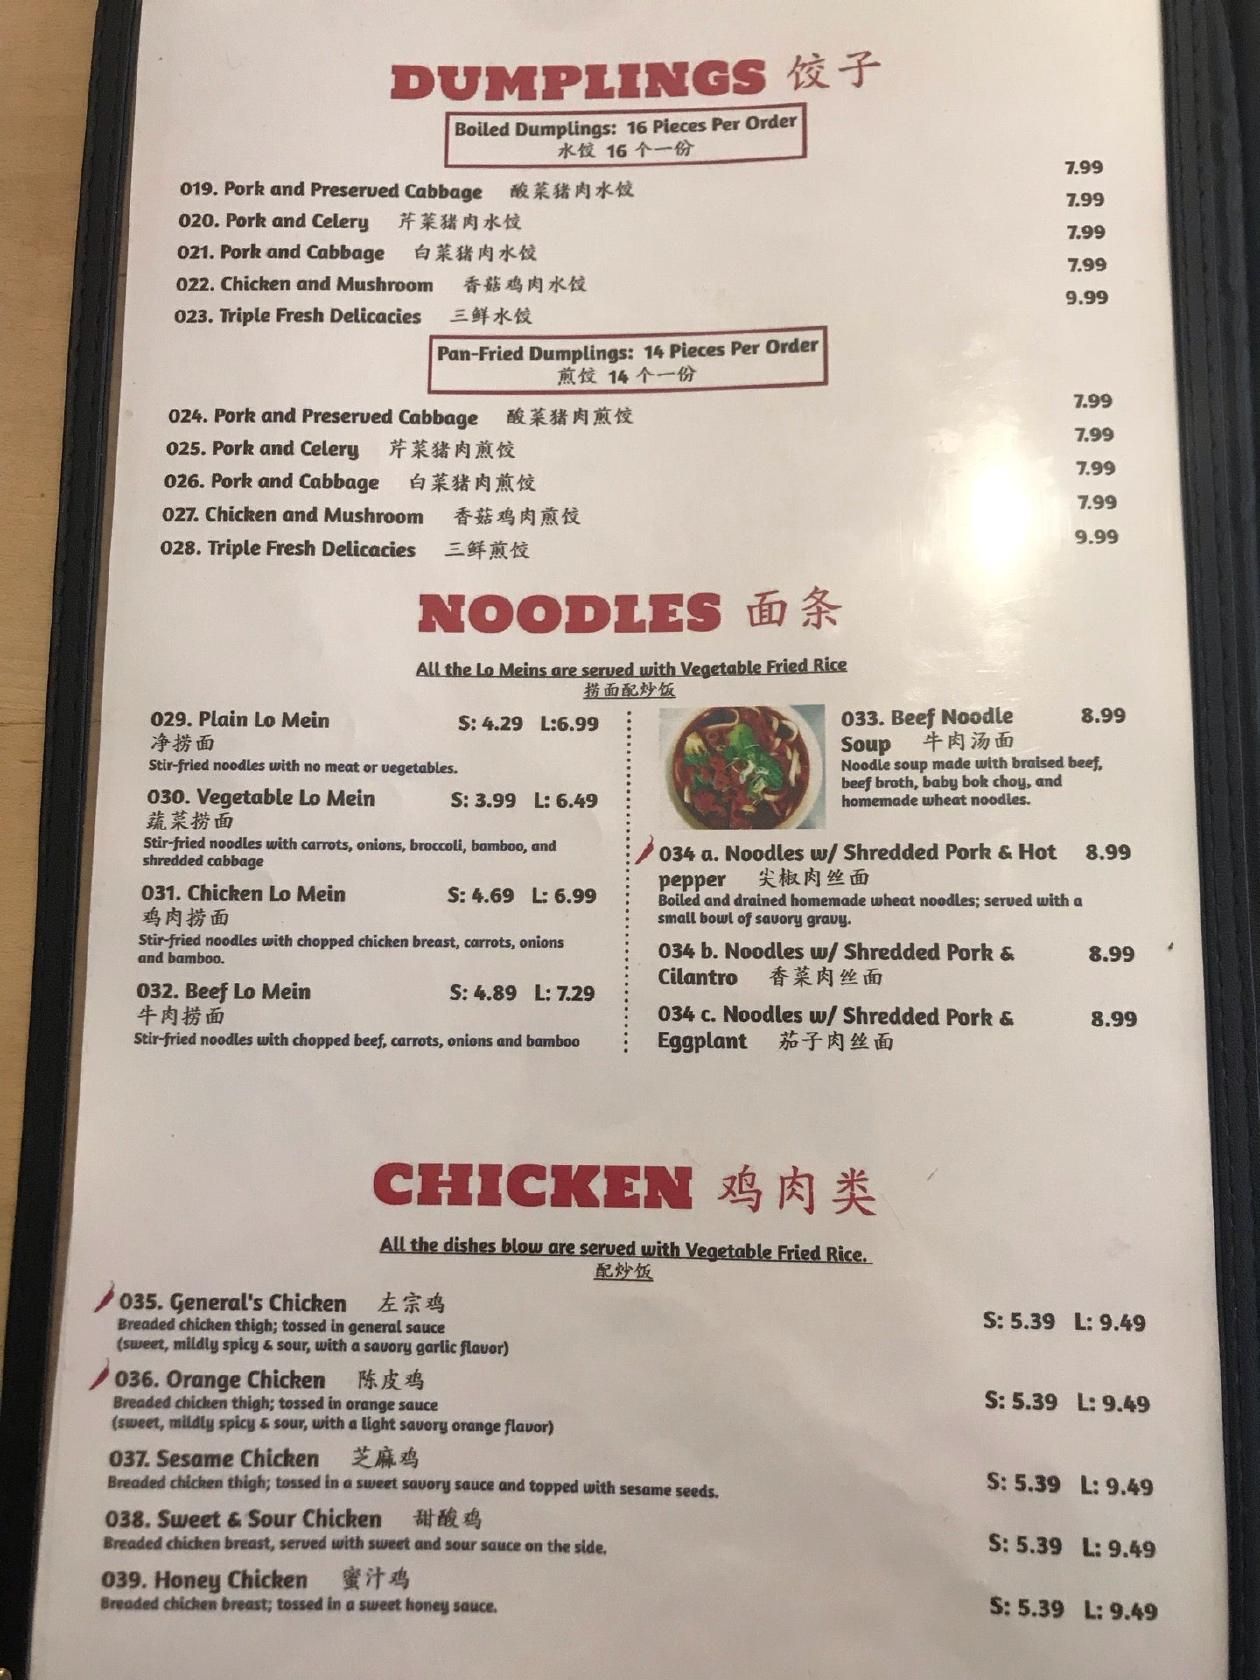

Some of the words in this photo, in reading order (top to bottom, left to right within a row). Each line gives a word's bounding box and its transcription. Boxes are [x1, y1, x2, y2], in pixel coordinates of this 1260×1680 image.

[391, 59, 766, 101] DUMPLINGS
[787, 50, 881, 90] 饺子
[455, 121, 510, 137] Boiled
[515, 120, 617, 140] Dumplings:
[627, 121, 648, 135] 16
[653, 117, 708, 134] Pieces
[711, 116, 741, 132] Per
[745, 113, 798, 131] Order
[558, 141, 596, 160] 水饺
[606, 144, 628, 159] 16
[635, 139, 695, 159] 个一份
[1065, 160, 1103, 175] 7.99
[180, 181, 218, 197] 019.
[225, 180, 265, 197] Pork
[270, 180, 305, 197] and
[311, 182, 399, 199] Preserved
[405, 183, 482, 203] Cabbage
[510, 179, 634, 200] 酸菜猪肉水饺
[1066, 192, 1105, 208] 7.99
[178, 212, 220, 229] 020.
[225, 211, 267, 228] Pork
[271, 212, 306, 229] and
[311, 212, 369, 233] Celery
[398, 212, 522, 231] 芹菜猪肉水饺
[1067, 224, 1106, 240] 7.99
[176, 245, 214, 261] 021.
[220, 243, 262, 260] Pork
[264, 243, 301, 260] and
[306, 243, 385, 264] Cabbage
[414, 243, 537, 263] 白菜猪肉水饺
[1066, 290, 1108, 306] 9.99
[174, 309, 214, 324] 023.
[219, 306, 271, 327] Triple
[275, 307, 325, 324] Fresh
[329, 307, 422, 325] Delicacies
[450, 306, 532, 326] 三鲜水饺
[437, 345, 524, 362] Pan-Fried
[529, 344, 634, 364] Dumplings:
[644, 344, 665, 360] 14
[669, 341, 726, 359] Pieces
[731, 340, 761, 357] Per
[765, 337, 820, 355] Order
[557, 366, 598, 387] 煎饺
[608, 369, 630, 385] 14
[636, 365, 697, 385] 个一份
[1074, 529, 1119, 545] 9.99
[159, 540, 201, 557] 028.
[207, 538, 262, 560] Triple
[265, 539, 316, 557] Fresh
[321, 540, 416, 558] Delicacies
[444, 539, 530, 560] 三鲜煎饺
[417, 592, 721, 634] NOODLES
[746, 585, 842, 630] 面条
[416, 662, 440, 677] All
[445, 662, 472, 676] the
[476, 663, 494, 677] Lo
[500, 662, 547, 677] Meins
[551, 666, 577, 677] are
[581, 662, 634, 677] served
[639, 662, 676, 676] with
[681, 660, 761, 679] Vegetable
[767, 658, 808, 674] Fried
[813, 657, 847, 672] Rice
[584, 682, 675, 698] 捞面配炒饭
[151, 711, 192, 728] 029.
[199, 709, 248, 728] Plain
[255, 711, 276, 728] Lo
[281, 711, 329, 729] Mein
[458, 714, 477, 732] S:
[481, 715, 523, 732] 4.29
[841, 710, 885, 727] 033.
[892, 707, 937, 731] Beef
[941, 706, 1014, 726] Noodle
[1081, 706, 1126, 724] 8.99
[151, 732, 214, 753] 净捞面
[841, 735, 891, 757] Soup
[922, 730, 1014, 753] 牛肉汤面
[148, 758, 210, 774] Stir-fried
[212, 758, 265, 772] noodles
[268, 758, 300, 772] with
[303, 762, 321, 773] no
[324, 761, 360, 774] meat
[362, 763, 378, 774] or
[380, 761, 458, 776] vegetables.
[842, 775, 872, 793] beef
[875, 775, 919, 791] broth,
[922, 775, 958, 792] baby
[962, 773, 989, 788] bok
[992, 773, 1032, 791] choy,
[1035, 773, 1062, 788] and
[657, 966, 738, 986] Cilantro
[769, 965, 883, 988] 香菜肉丝面
[137, 982, 180, 999] 032.
[185, 981, 230, 1005] Beef
[234, 982, 256, 1000] Lo
[262, 982, 312, 1001] Mein
[449, 983, 468, 1002] S:
[473, 984, 517, 1002] 4.89
[534, 983, 551, 1002] L:
[556, 985, 596, 1003] 7.29
[137, 1004, 225, 1026] 牛肉捞面
[657, 1004, 696, 1023] 034
[700, 1009, 717, 1023] c.
[723, 1004, 803, 1024] Noodles
[808, 1004, 838, 1027] w/
[842, 1005, 940, 1026] Shredded
[946, 1007, 993, 1027] Pork
[998, 1010, 1014, 1026] &
[1091, 1010, 1138, 1028] 8.99
[657, 1031, 748, 1055] Eggplant
[778, 1029, 893, 1052] 茄子肉丝面
[374, 1162, 693, 1209] CHICKEN
[718, 1164, 877, 1216] 鸡肉类
[380, 1236, 405, 1253] All
[410, 1237, 438, 1253] the
[444, 1237, 496, 1253] dishes
[501, 1238, 543, 1254] blow
[549, 1243, 575, 1255] are
[580, 1240, 635, 1256] served
[641, 1240, 680, 1257] with
[685, 1242, 772, 1262] Vegetable
[778, 1244, 821, 1261] Fried
[826, 1245, 867, 1263] Rice.
[596, 1262, 651, 1279] 配炒饭
[118, 1292, 163, 1311] 035.
[169, 1292, 263, 1315] General's
[268, 1292, 347, 1313] Chicken
[377, 1291, 445, 1314] 左宗鸡
[983, 1311, 1004, 1330] S:
[1010, 1311, 1056, 1331] 5.39
[1074, 1312, 1093, 1331] L:
[1099, 1313, 1146, 1333] 9.49
[100, 1570, 147, 1590] 039.
[153, 1569, 221, 1595] Honey
[227, 1567, 308, 1591] Chicken
[342, 1565, 410, 1592] 蜜汁鸡
[100, 1596, 159, 1612] Breaded
[162, 1595, 218, 1612] chicken
[220, 1596, 272, 1613] breast;
[276, 1596, 324, 1612] tossed
[326, 1596, 341, 1612] in
[345, 1600, 355, 1612] a
[358, 1598, 402, 1613] sweet
[405, 1596, 450, 1617] honey
[452, 1601, 497, 1614] sauce.
[989, 1595, 1010, 1617] S:
[1017, 1598, 1065, 1620] 5.39
[1084, 1599, 1103, 1620] L:
[1109, 1601, 1159, 1622] 9.49
